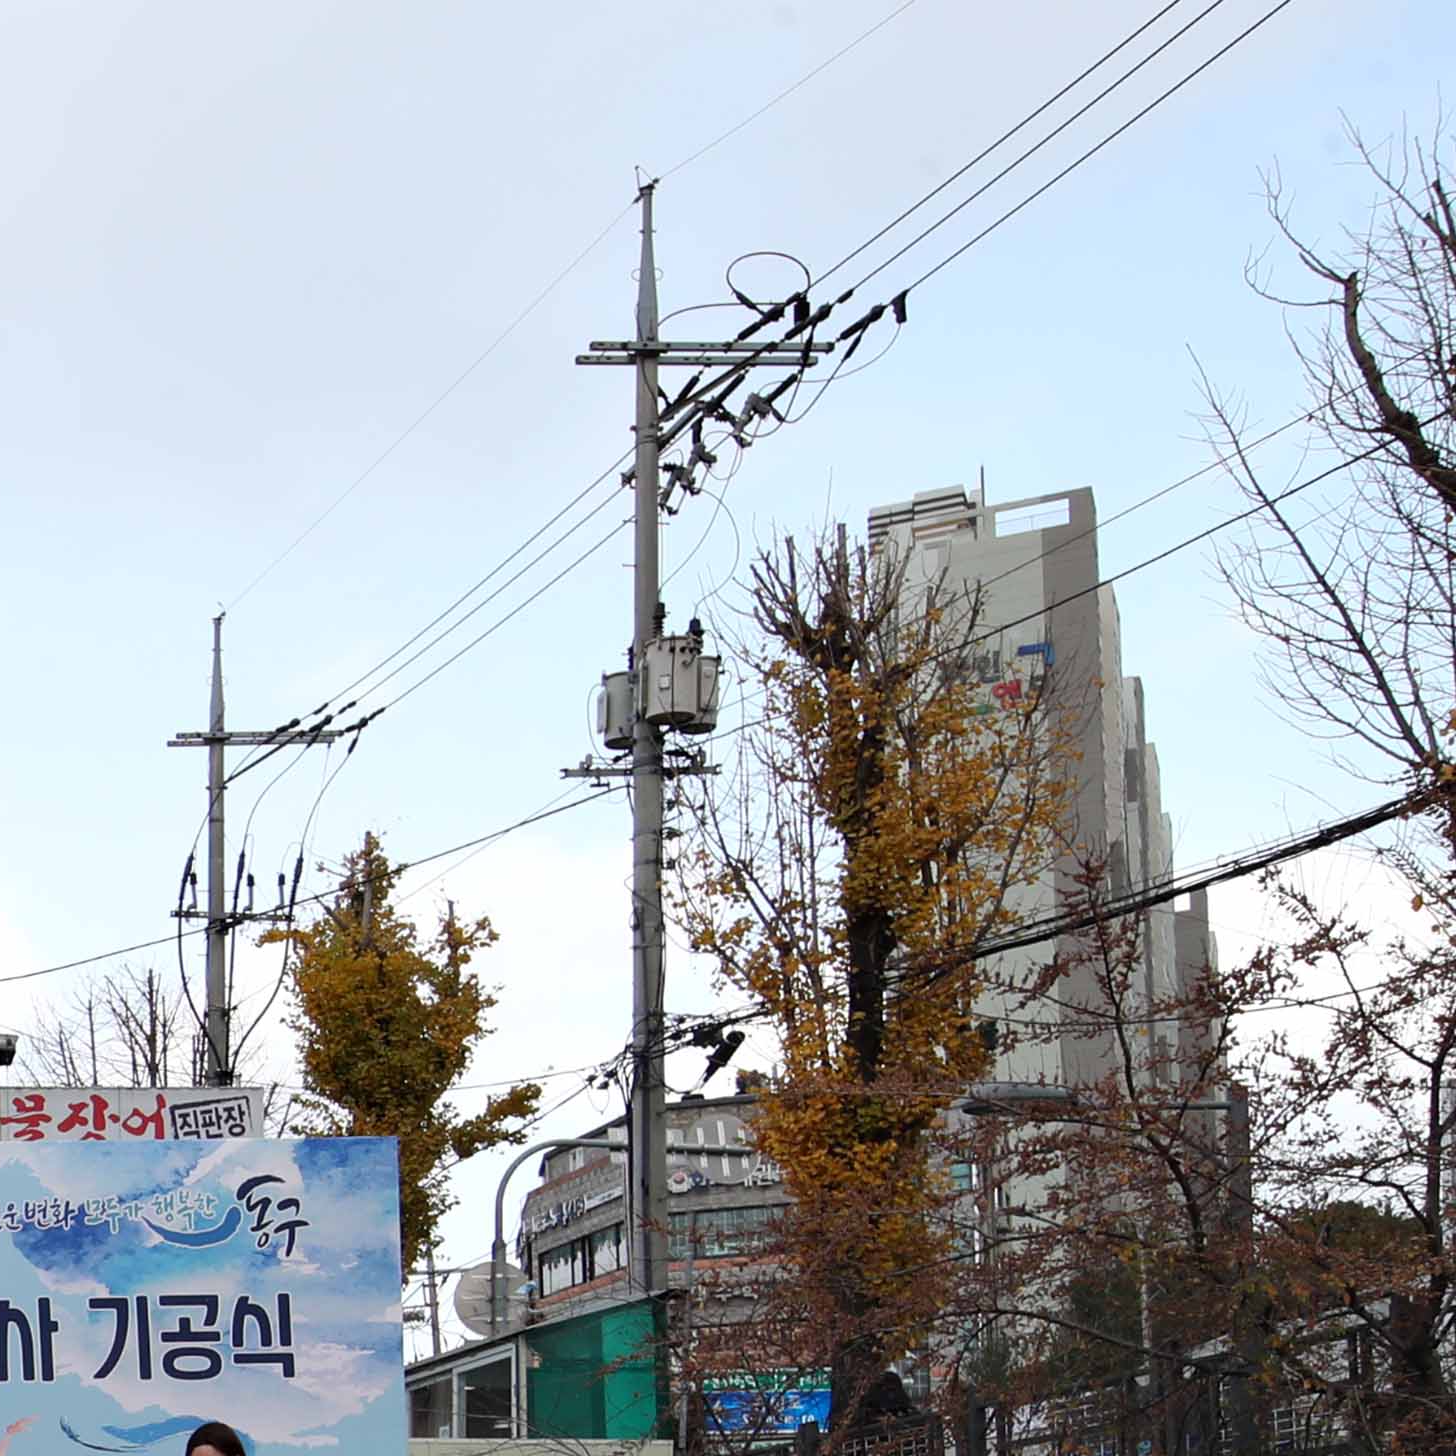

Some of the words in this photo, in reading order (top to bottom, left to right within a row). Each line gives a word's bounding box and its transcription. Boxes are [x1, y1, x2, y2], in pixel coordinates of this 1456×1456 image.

[24, 1199, 76, 1232] 변화
[152, 1193, 217, 1230] 행복한
[236, 1174, 311, 1257] 동구
[89, 1292, 296, 1381] 기공식
